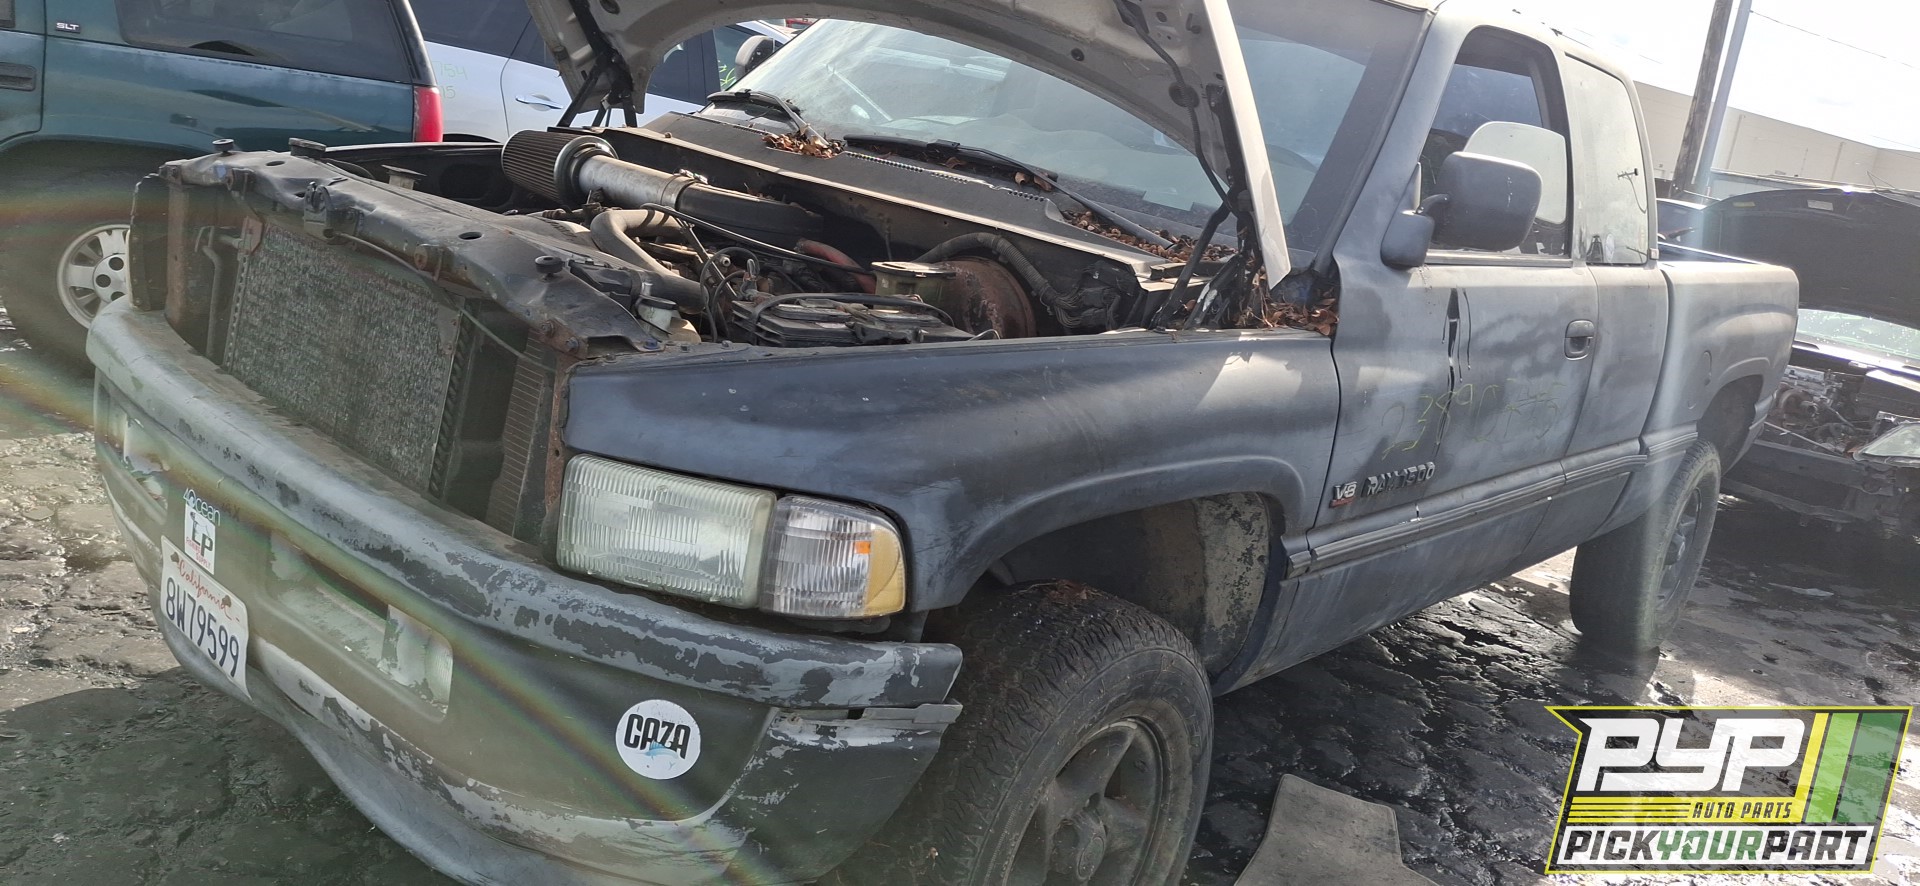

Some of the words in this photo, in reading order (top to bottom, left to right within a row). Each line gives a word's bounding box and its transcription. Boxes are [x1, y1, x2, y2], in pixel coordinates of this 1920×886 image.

[56, 22, 79, 31] SLT
[178, 559, 232, 620] California
[165, 577, 239, 678] 8W79599
[624, 713, 691, 760] CAZA
